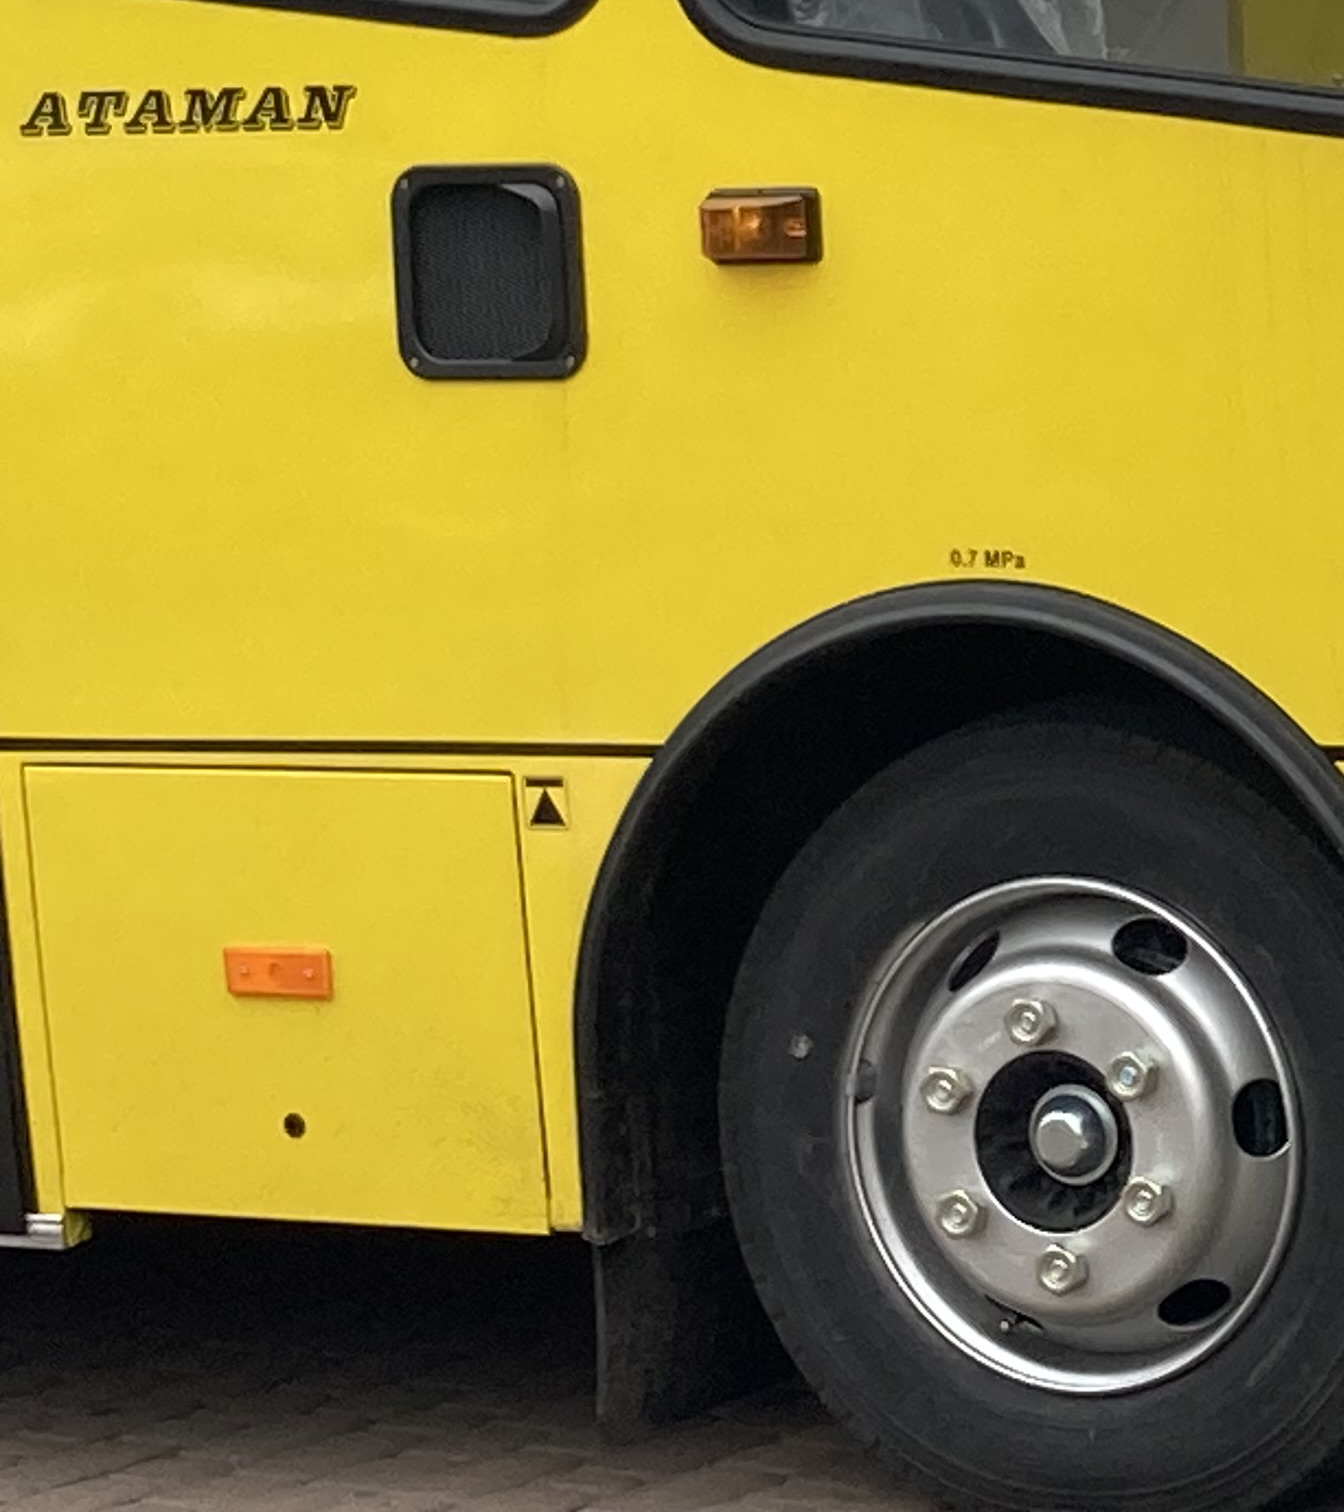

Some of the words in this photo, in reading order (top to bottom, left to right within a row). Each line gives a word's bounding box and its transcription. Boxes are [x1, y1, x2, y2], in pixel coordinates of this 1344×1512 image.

[20, 84, 357, 137] ATAMAN
[949, 547, 979, 569] 0.7
[983, 549, 1026, 570] MPa
